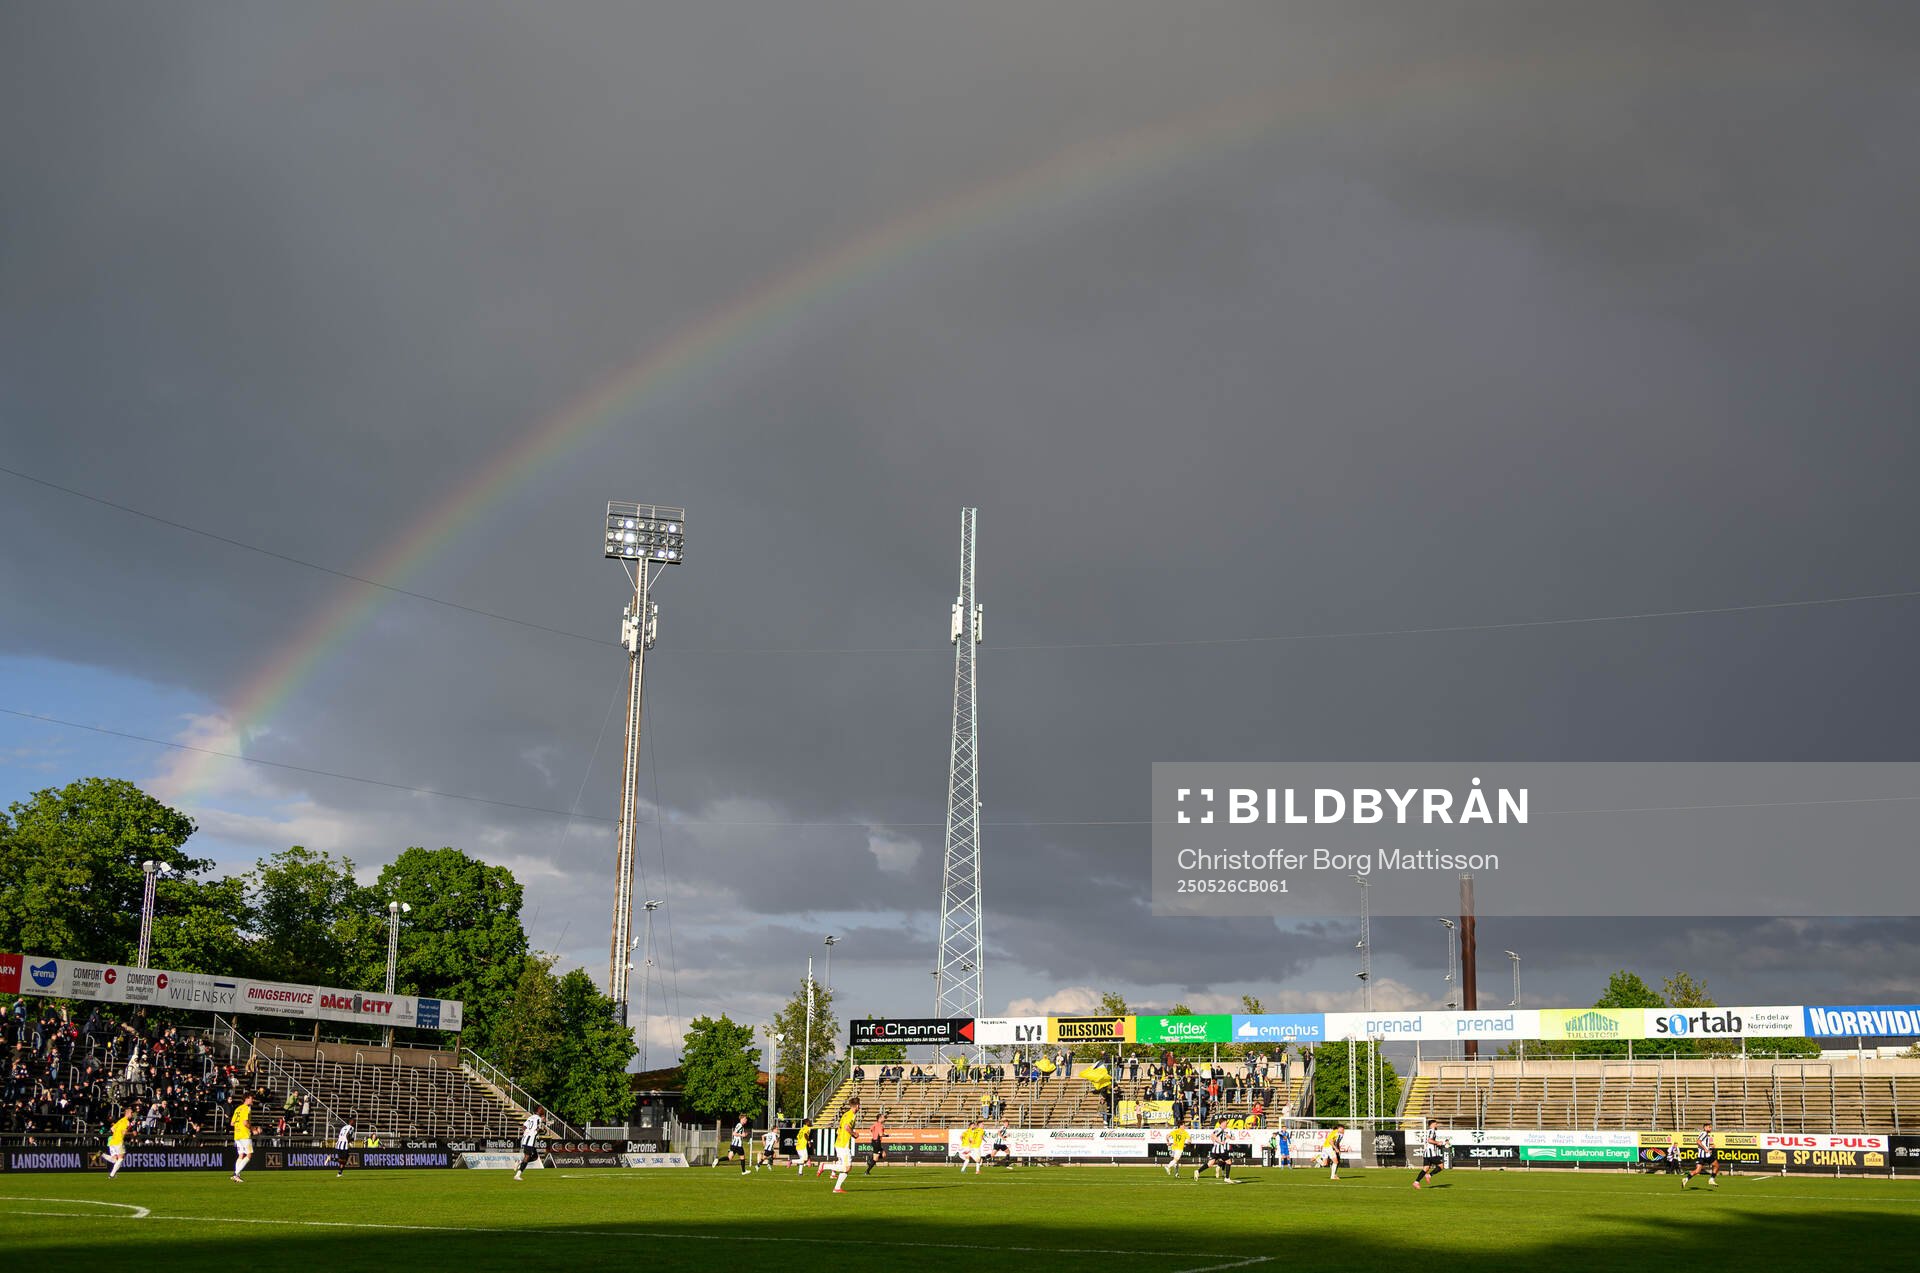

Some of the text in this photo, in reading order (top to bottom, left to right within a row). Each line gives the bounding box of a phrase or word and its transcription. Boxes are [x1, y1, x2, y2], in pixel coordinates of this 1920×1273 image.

[73, 967, 104, 981] COMFORT
[127, 973, 156, 986] COMFORT
[170, 988, 235, 1005] WILENSKY
[247, 988, 314, 1004] RINGSERVICE
[320, 994, 353, 1010] DÄCK
[362, 1001, 393, 1014] CITY
[1167, 1023, 1207, 1035] alfdex
[1366, 1016, 1422, 1034] prenad
[1457, 1015, 1514, 1036] prenad
[1565, 1012, 1619, 1032] VÄXTHUSET
[1748, 1023, 1793, 1031] Norrvidinge
[856, 1022, 950, 1037] InfoChannel
[1015, 1025, 1042, 1041] LY!
[1059, 1024, 1114, 1037] OHLSSONS
[1260, 1024, 1318, 1036] emrahus
[627, 1141, 657, 1152] Derome
[1767, 1137, 1816, 1147] PULS
[1830, 1137, 1881, 1148] PULS
[1470, 1147, 1513, 1158] stadium
[1560, 1149, 1630, 1158] Landskrona Energi
[1717, 1150, 1759, 1161] Reklam
[1793, 1151, 1856, 1166] SP CHARK
[11, 1153, 81, 1169] LANDSKRONA
[117, 1153, 165, 1168] ROFFSENS
[167, 1153, 223, 1168] HEMMAPLAN
[364, 1153, 404, 1167] PROFFSENS
[405, 1153, 447, 1166] HEMMAPLAN
